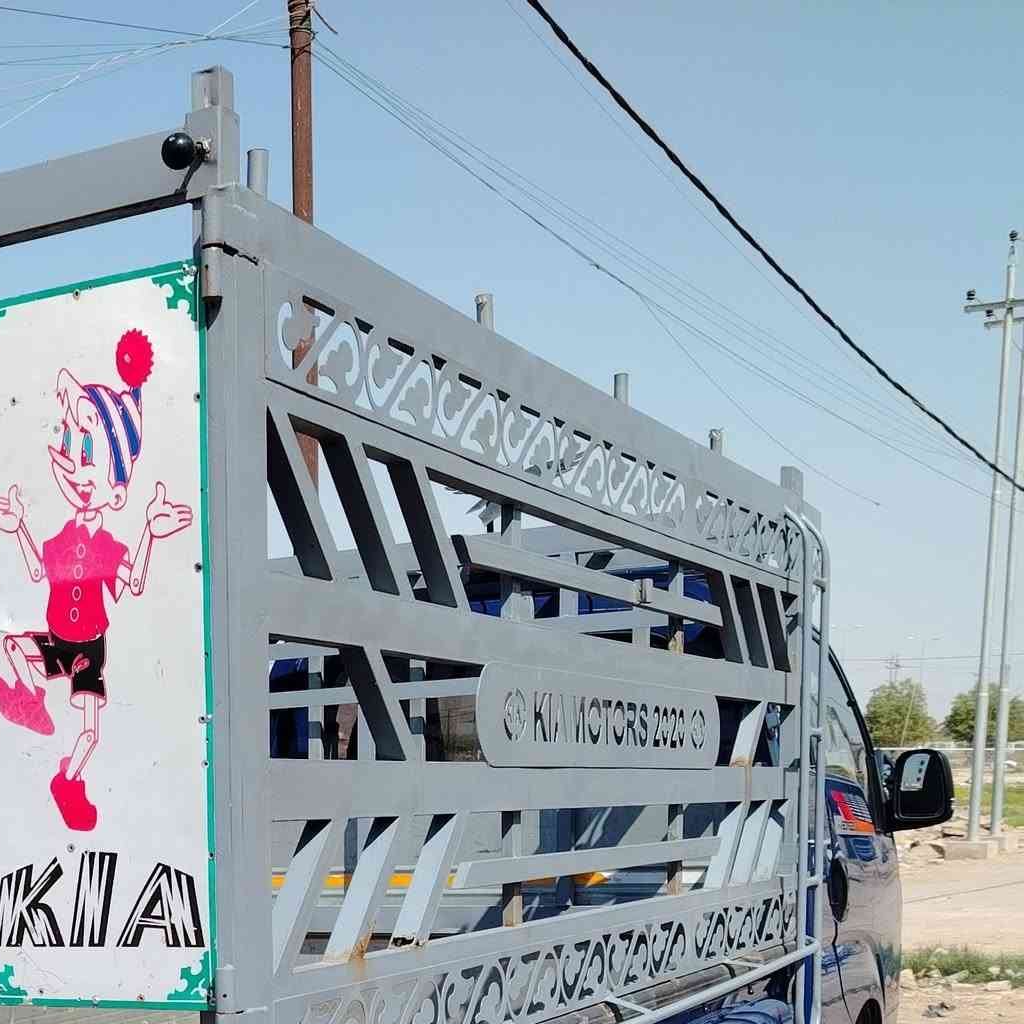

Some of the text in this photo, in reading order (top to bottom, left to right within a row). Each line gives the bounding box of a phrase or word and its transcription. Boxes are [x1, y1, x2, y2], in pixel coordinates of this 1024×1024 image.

[533, 691, 568, 743] KIA
[573, 695, 648, 748] MOTORS
[652, 705, 685, 749] 2020
